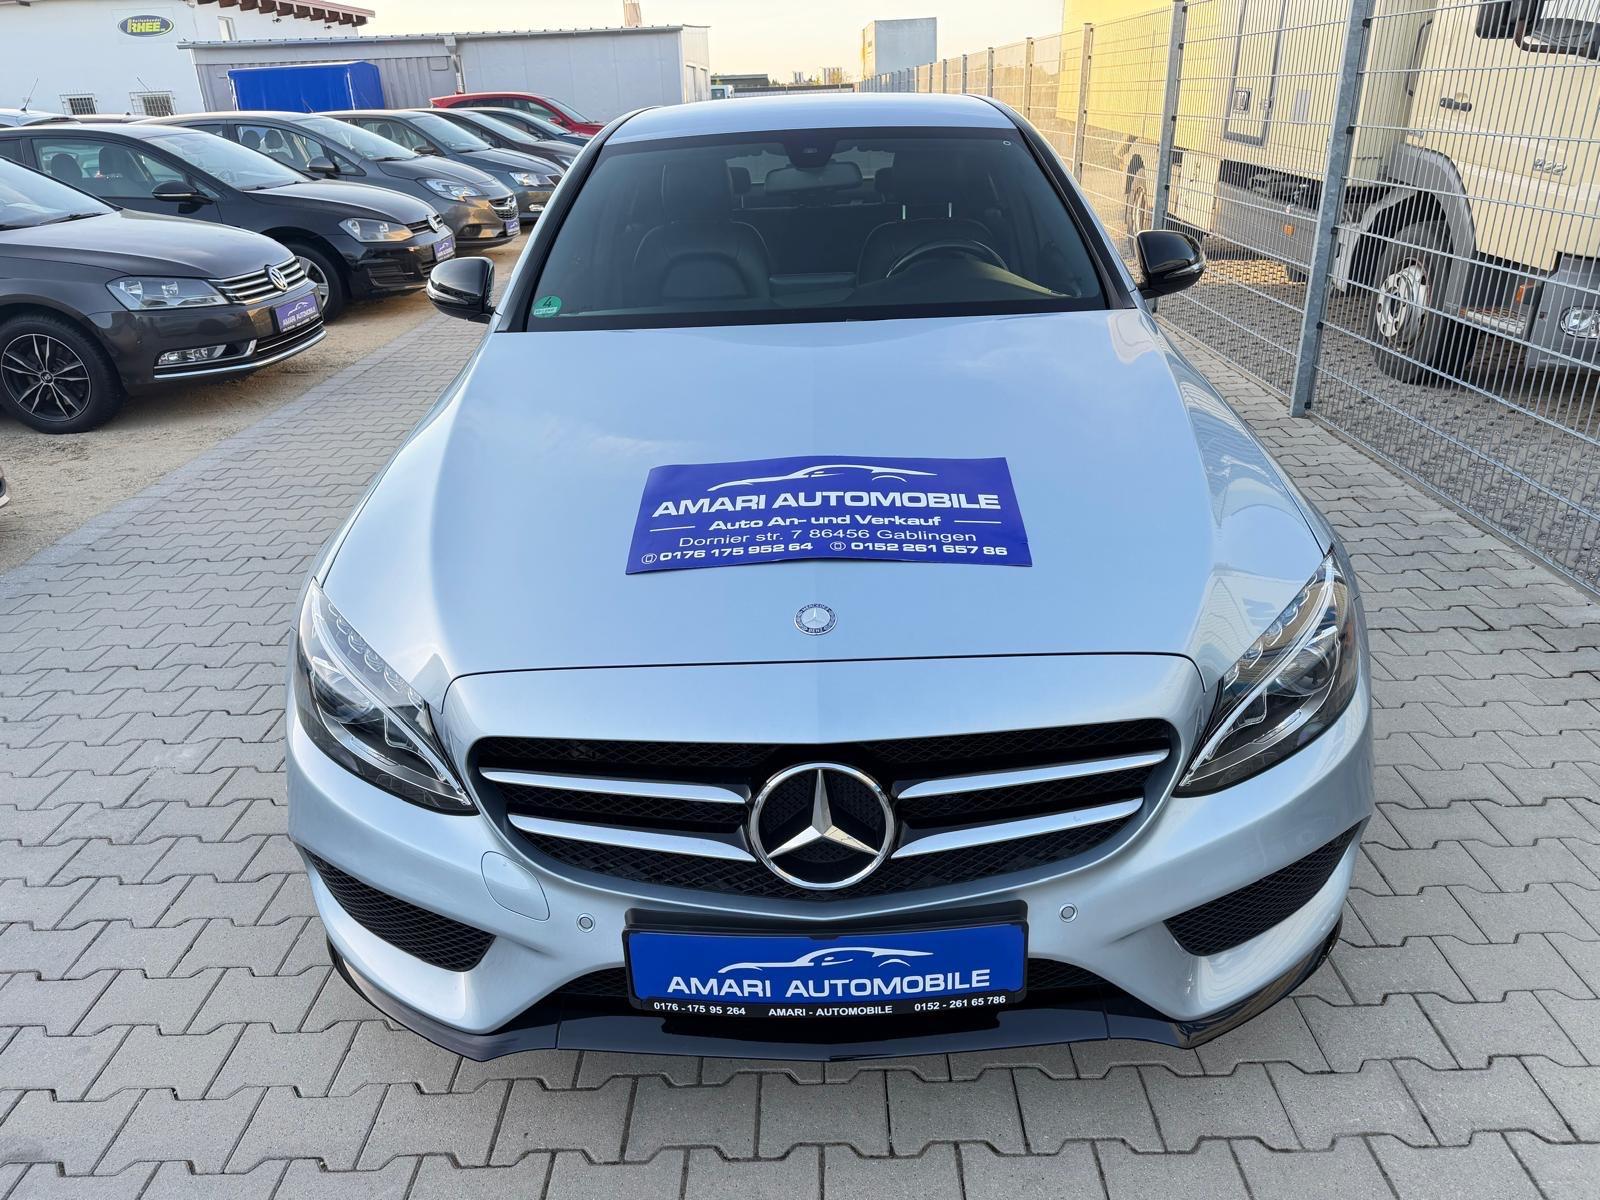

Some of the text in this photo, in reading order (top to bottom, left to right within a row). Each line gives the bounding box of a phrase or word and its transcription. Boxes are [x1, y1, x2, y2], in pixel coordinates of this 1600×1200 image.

[542, 296, 553, 308] 4
[651, 491, 1001, 518] AMARI AUTOMOBILE
[708, 514, 942, 531] Auto An- und Verkauf
[679, 528, 977, 547] Dornier str. 7 86456 Gablingen
[659, 542, 814, 561] 0176 175 952 64
[850, 542, 1008, 556] 0152 261 657 86
[667, 969, 991, 998] AMARI AUTOMOBILE
[653, 1002, 679, 1012] 0176
[688, 1004, 706, 1014] 175
[709, 1006, 723, 1014] 95
[726, 1007, 746, 1016] 264
[768, 1008, 806, 1017] AMARI
[815, 1005, 893, 1017] AUTOMOBILE
[914, 1001, 940, 1012] 0152
[949, 1000, 968, 1009] 261
[971, 998, 985, 1007] 65
[986, 995, 1006, 1005] 786
